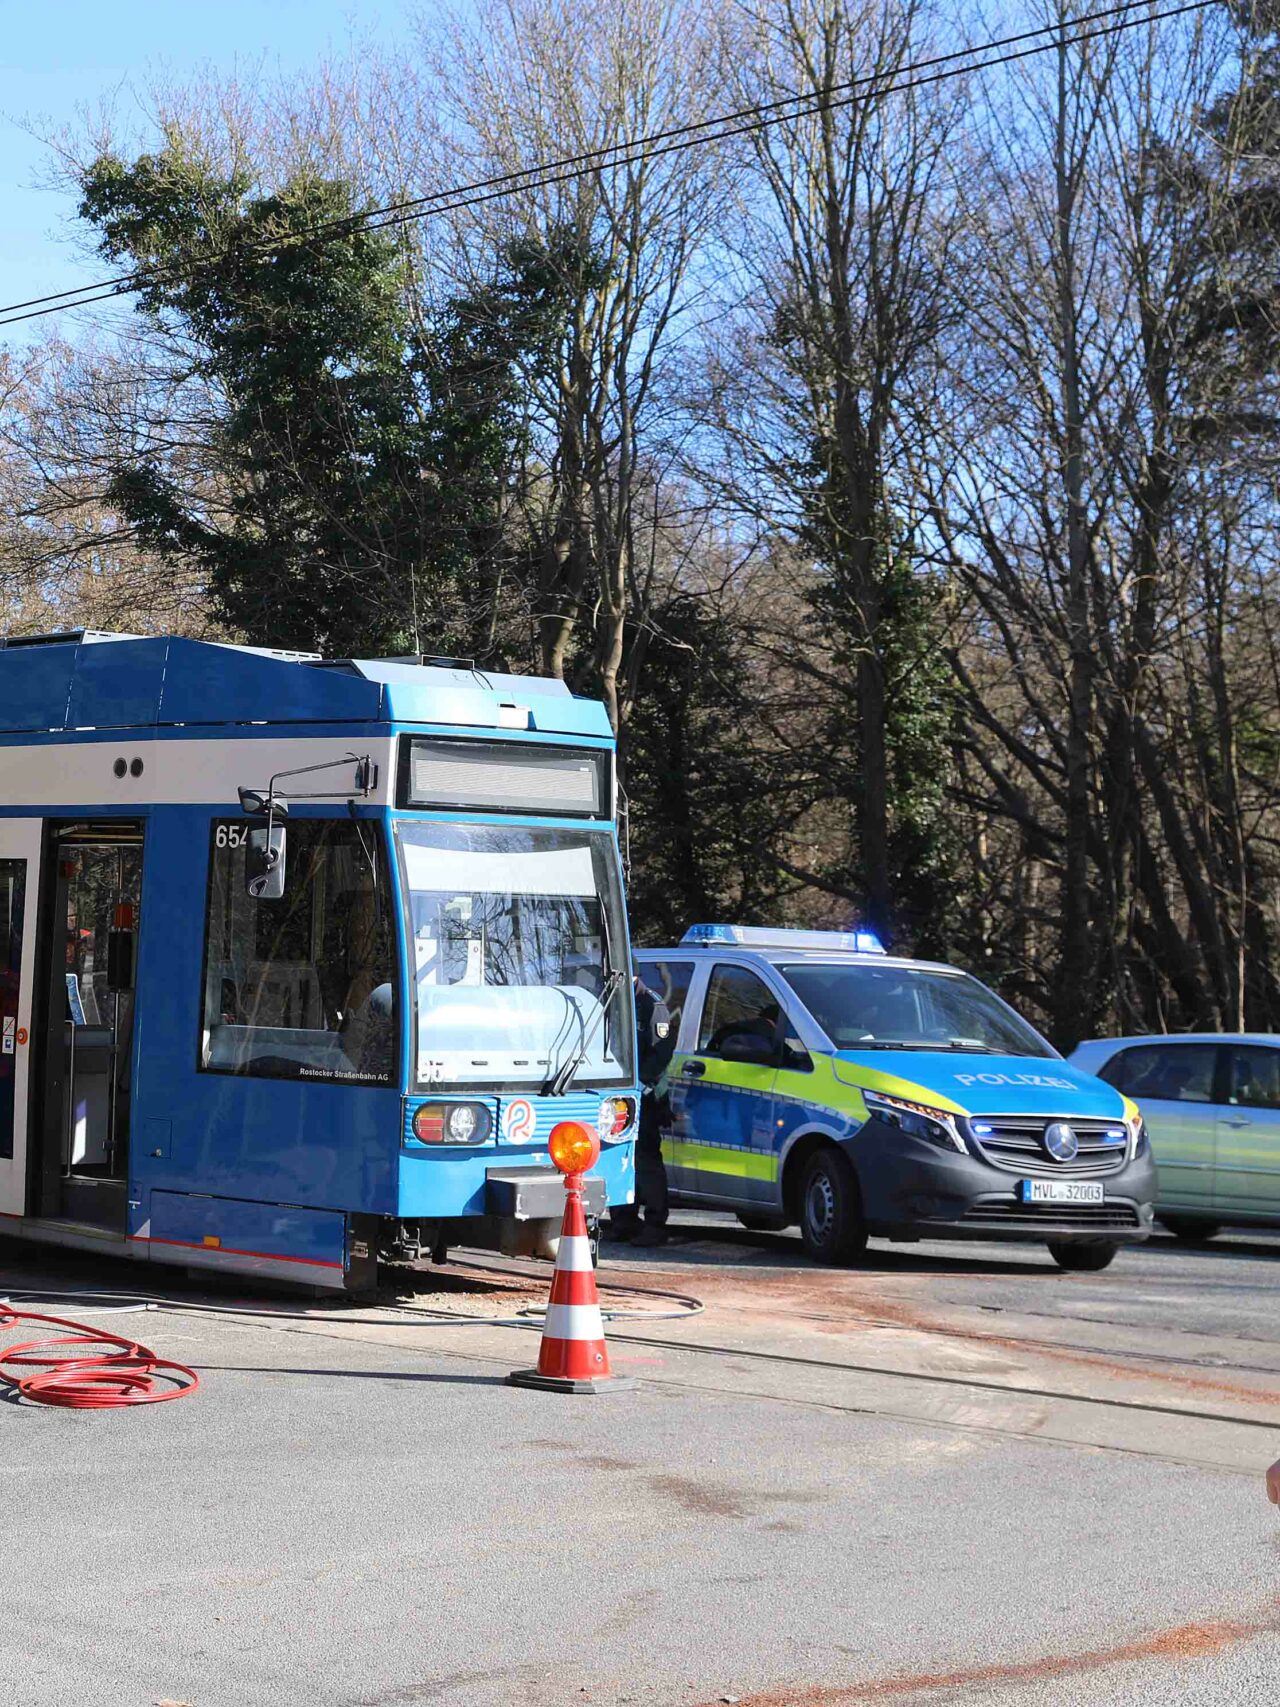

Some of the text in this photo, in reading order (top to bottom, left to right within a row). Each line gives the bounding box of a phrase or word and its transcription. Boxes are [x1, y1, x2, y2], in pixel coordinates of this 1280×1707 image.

[299, 1067, 389, 1081] Rostocker Straßenbahn AG
[952, 1073, 1079, 1090] POLIZEI
[1033, 1183, 1102, 1201] MVL 32003
